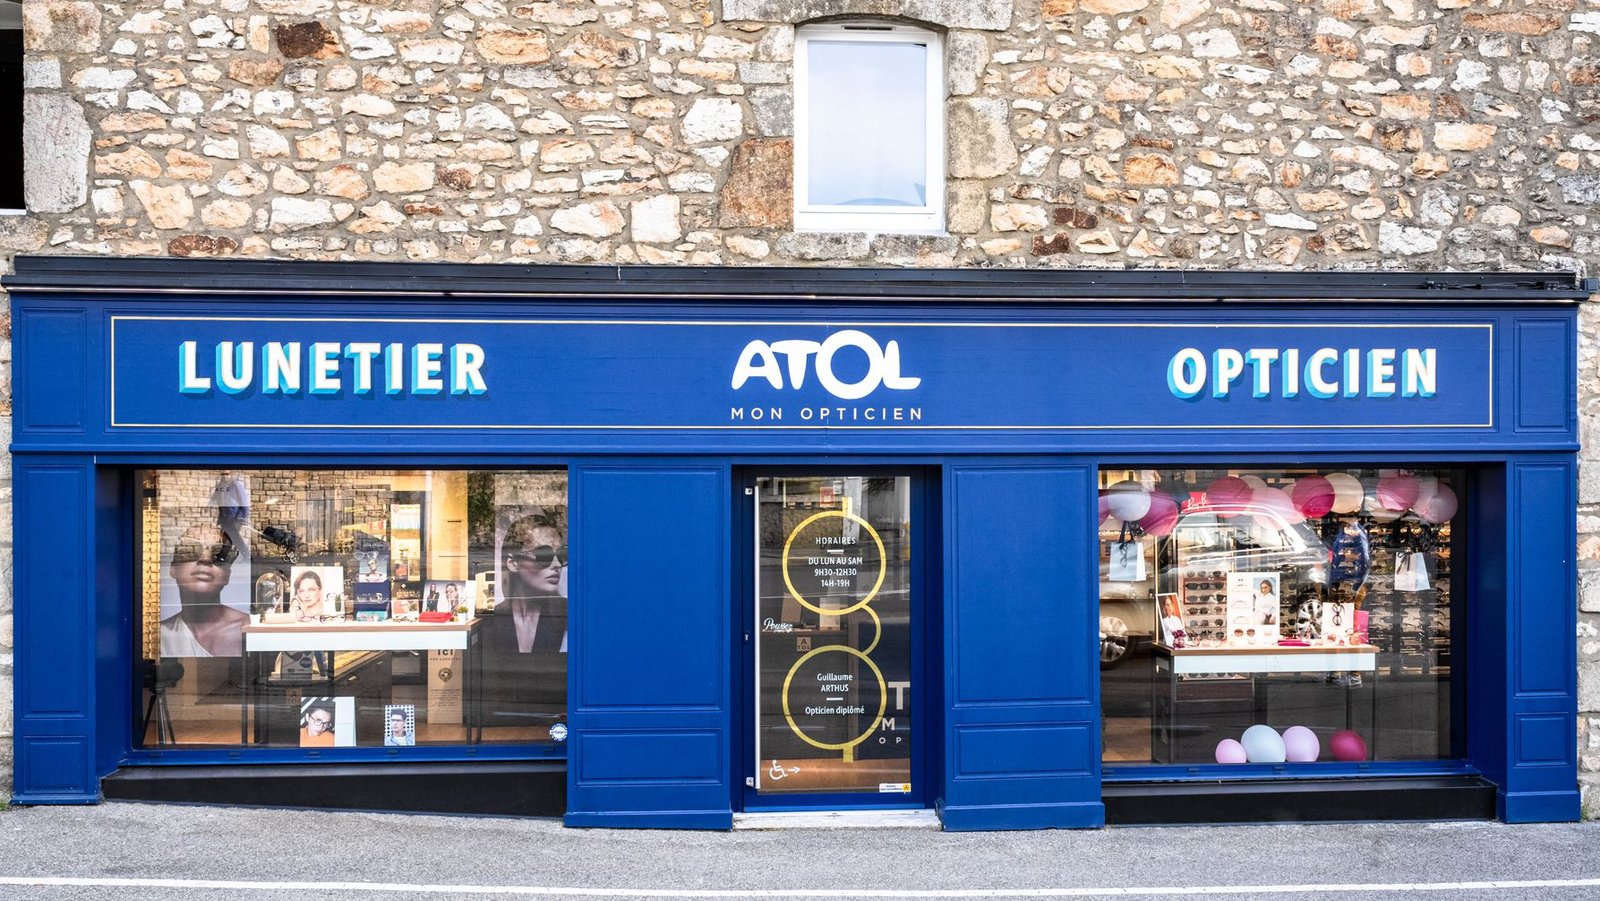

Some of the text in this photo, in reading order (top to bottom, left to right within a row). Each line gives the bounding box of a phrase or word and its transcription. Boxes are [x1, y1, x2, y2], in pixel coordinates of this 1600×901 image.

[179, 340, 488, 396] LUNETIER
[731, 329, 922, 400] ATOL
[1167, 347, 1437, 399] OPTICIEN
[731, 407, 922, 420] MON OPTICIEN
[815, 536, 856, 545] HORAIRES
[808, 557, 863, 565] DU LUN AU SAM
[814, 568, 857, 576] 9H30-12H30
[821, 579, 850, 587] 14H-19H
[762, 617, 793, 632] Poussez
[817, 673, 853, 682] Guillaume
[805, 705, 865, 716] Opticien diplômé
